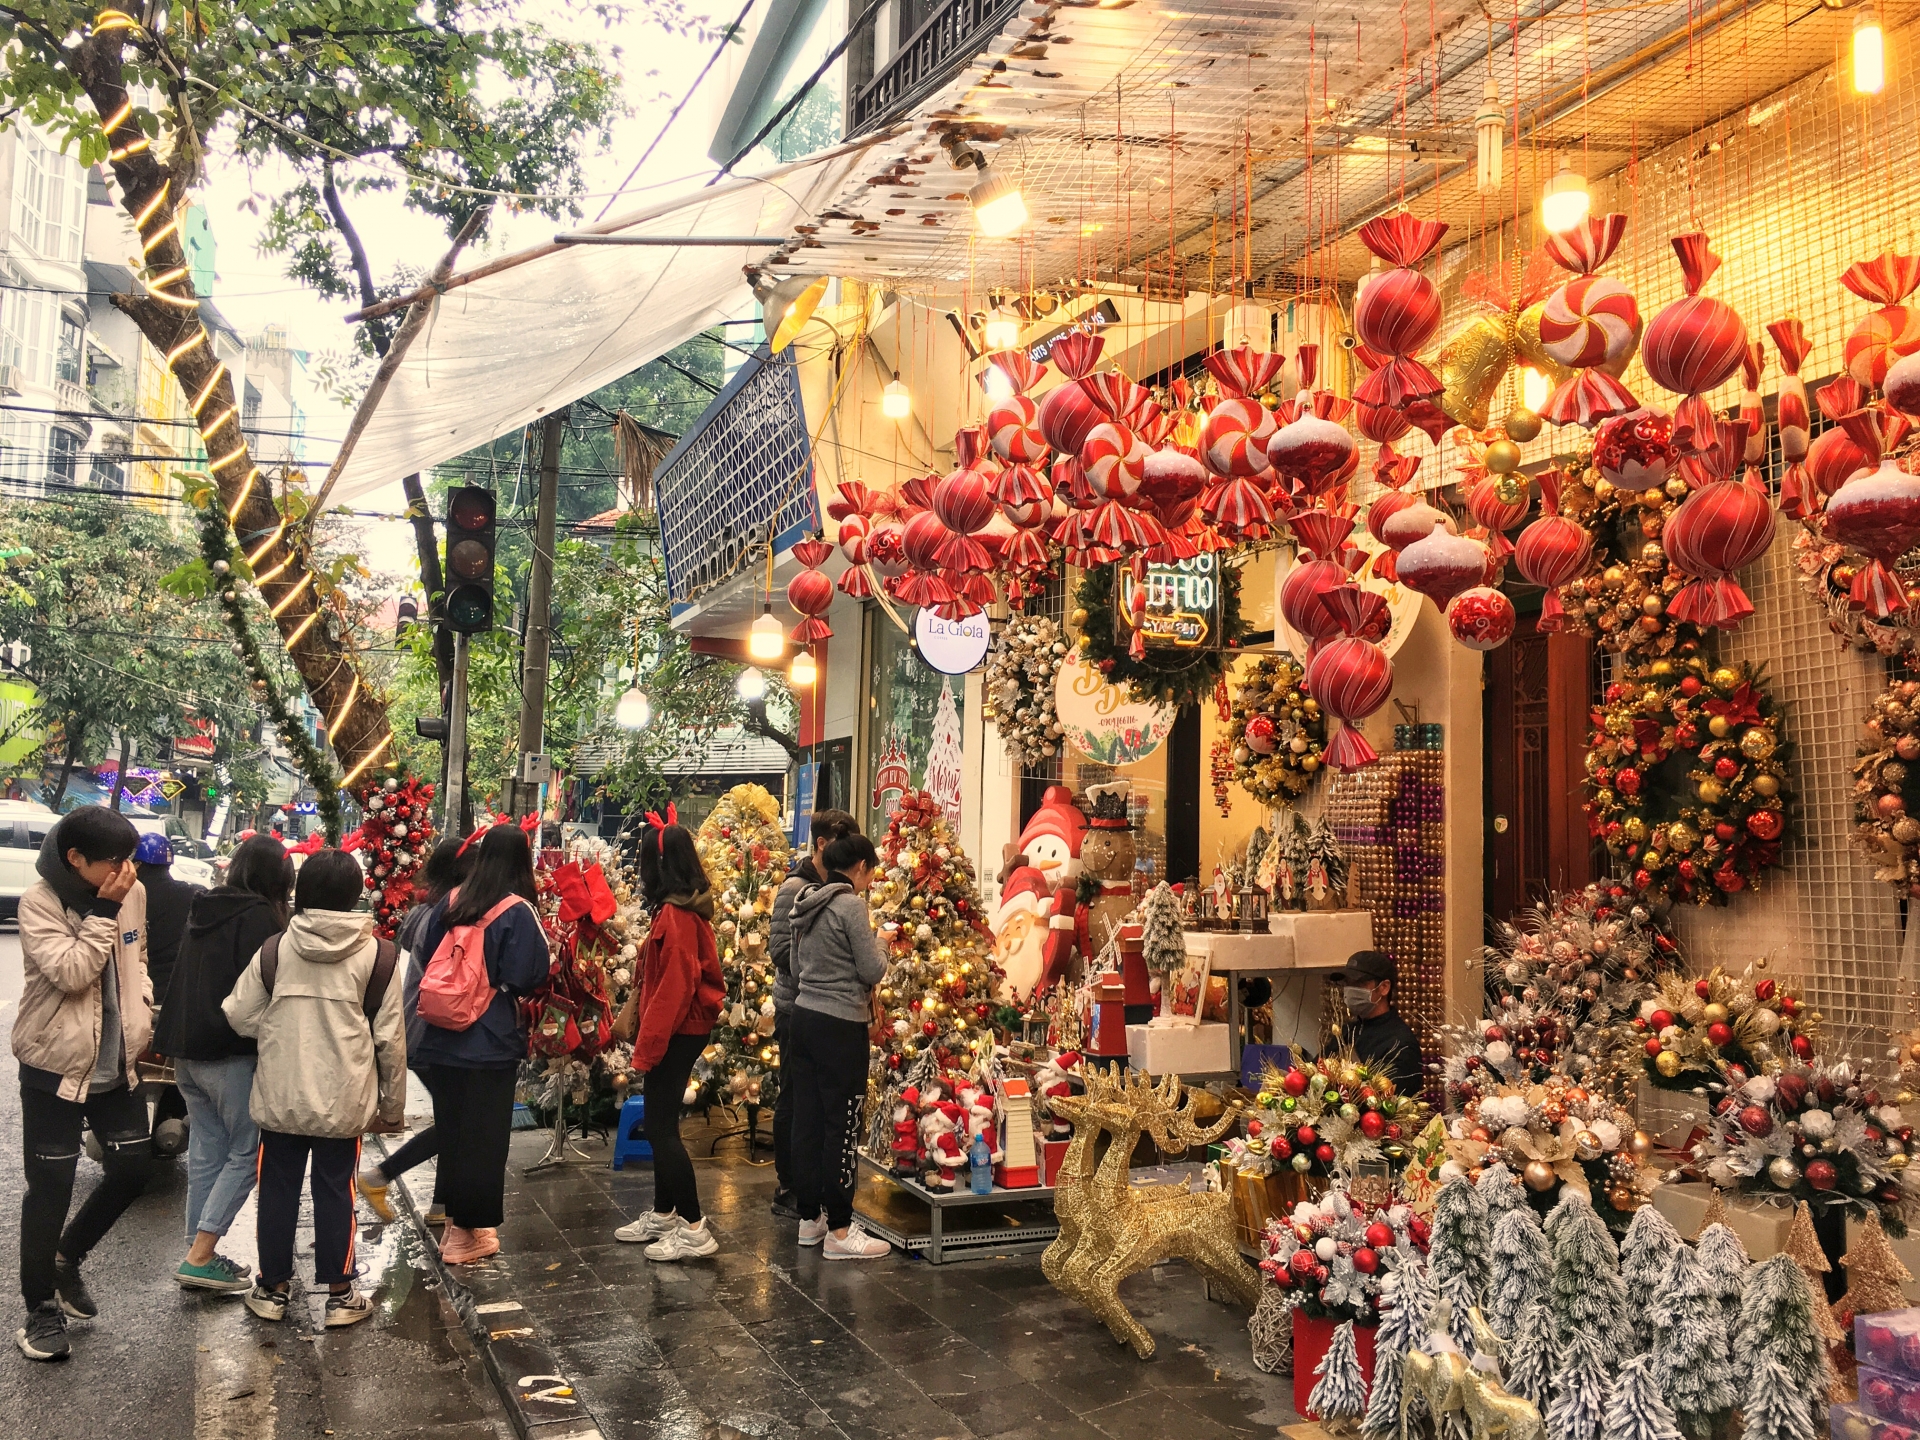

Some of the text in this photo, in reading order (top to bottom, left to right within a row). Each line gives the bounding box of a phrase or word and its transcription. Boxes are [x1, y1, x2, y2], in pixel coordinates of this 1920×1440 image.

[929, 618, 983, 639] La Gioia
[932, 764, 961, 798] Merry
